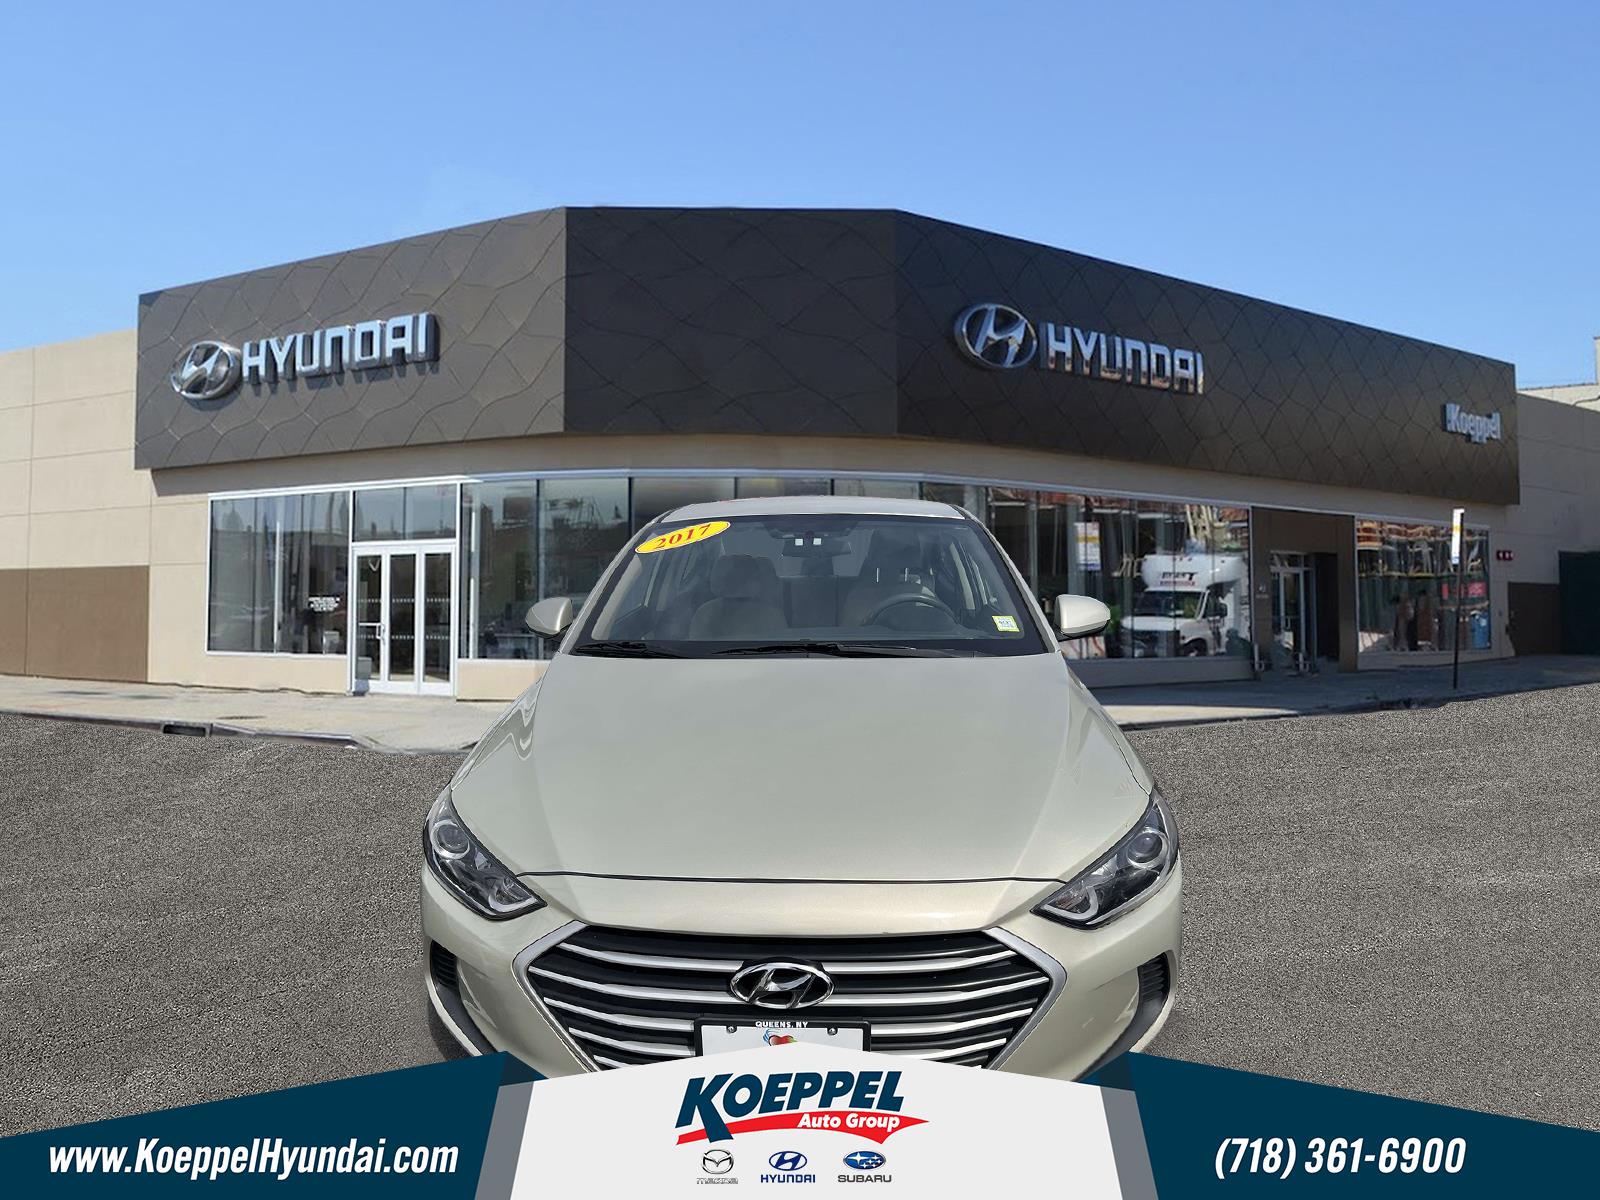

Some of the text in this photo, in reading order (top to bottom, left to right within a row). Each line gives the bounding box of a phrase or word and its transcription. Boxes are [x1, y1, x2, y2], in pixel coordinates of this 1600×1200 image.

[242, 311, 434, 382] HYUNDAI
[1046, 322, 1204, 394] HYUNDAI
[1445, 403, 1501, 443] Koeppel
[654, 523, 711, 549] 2017
